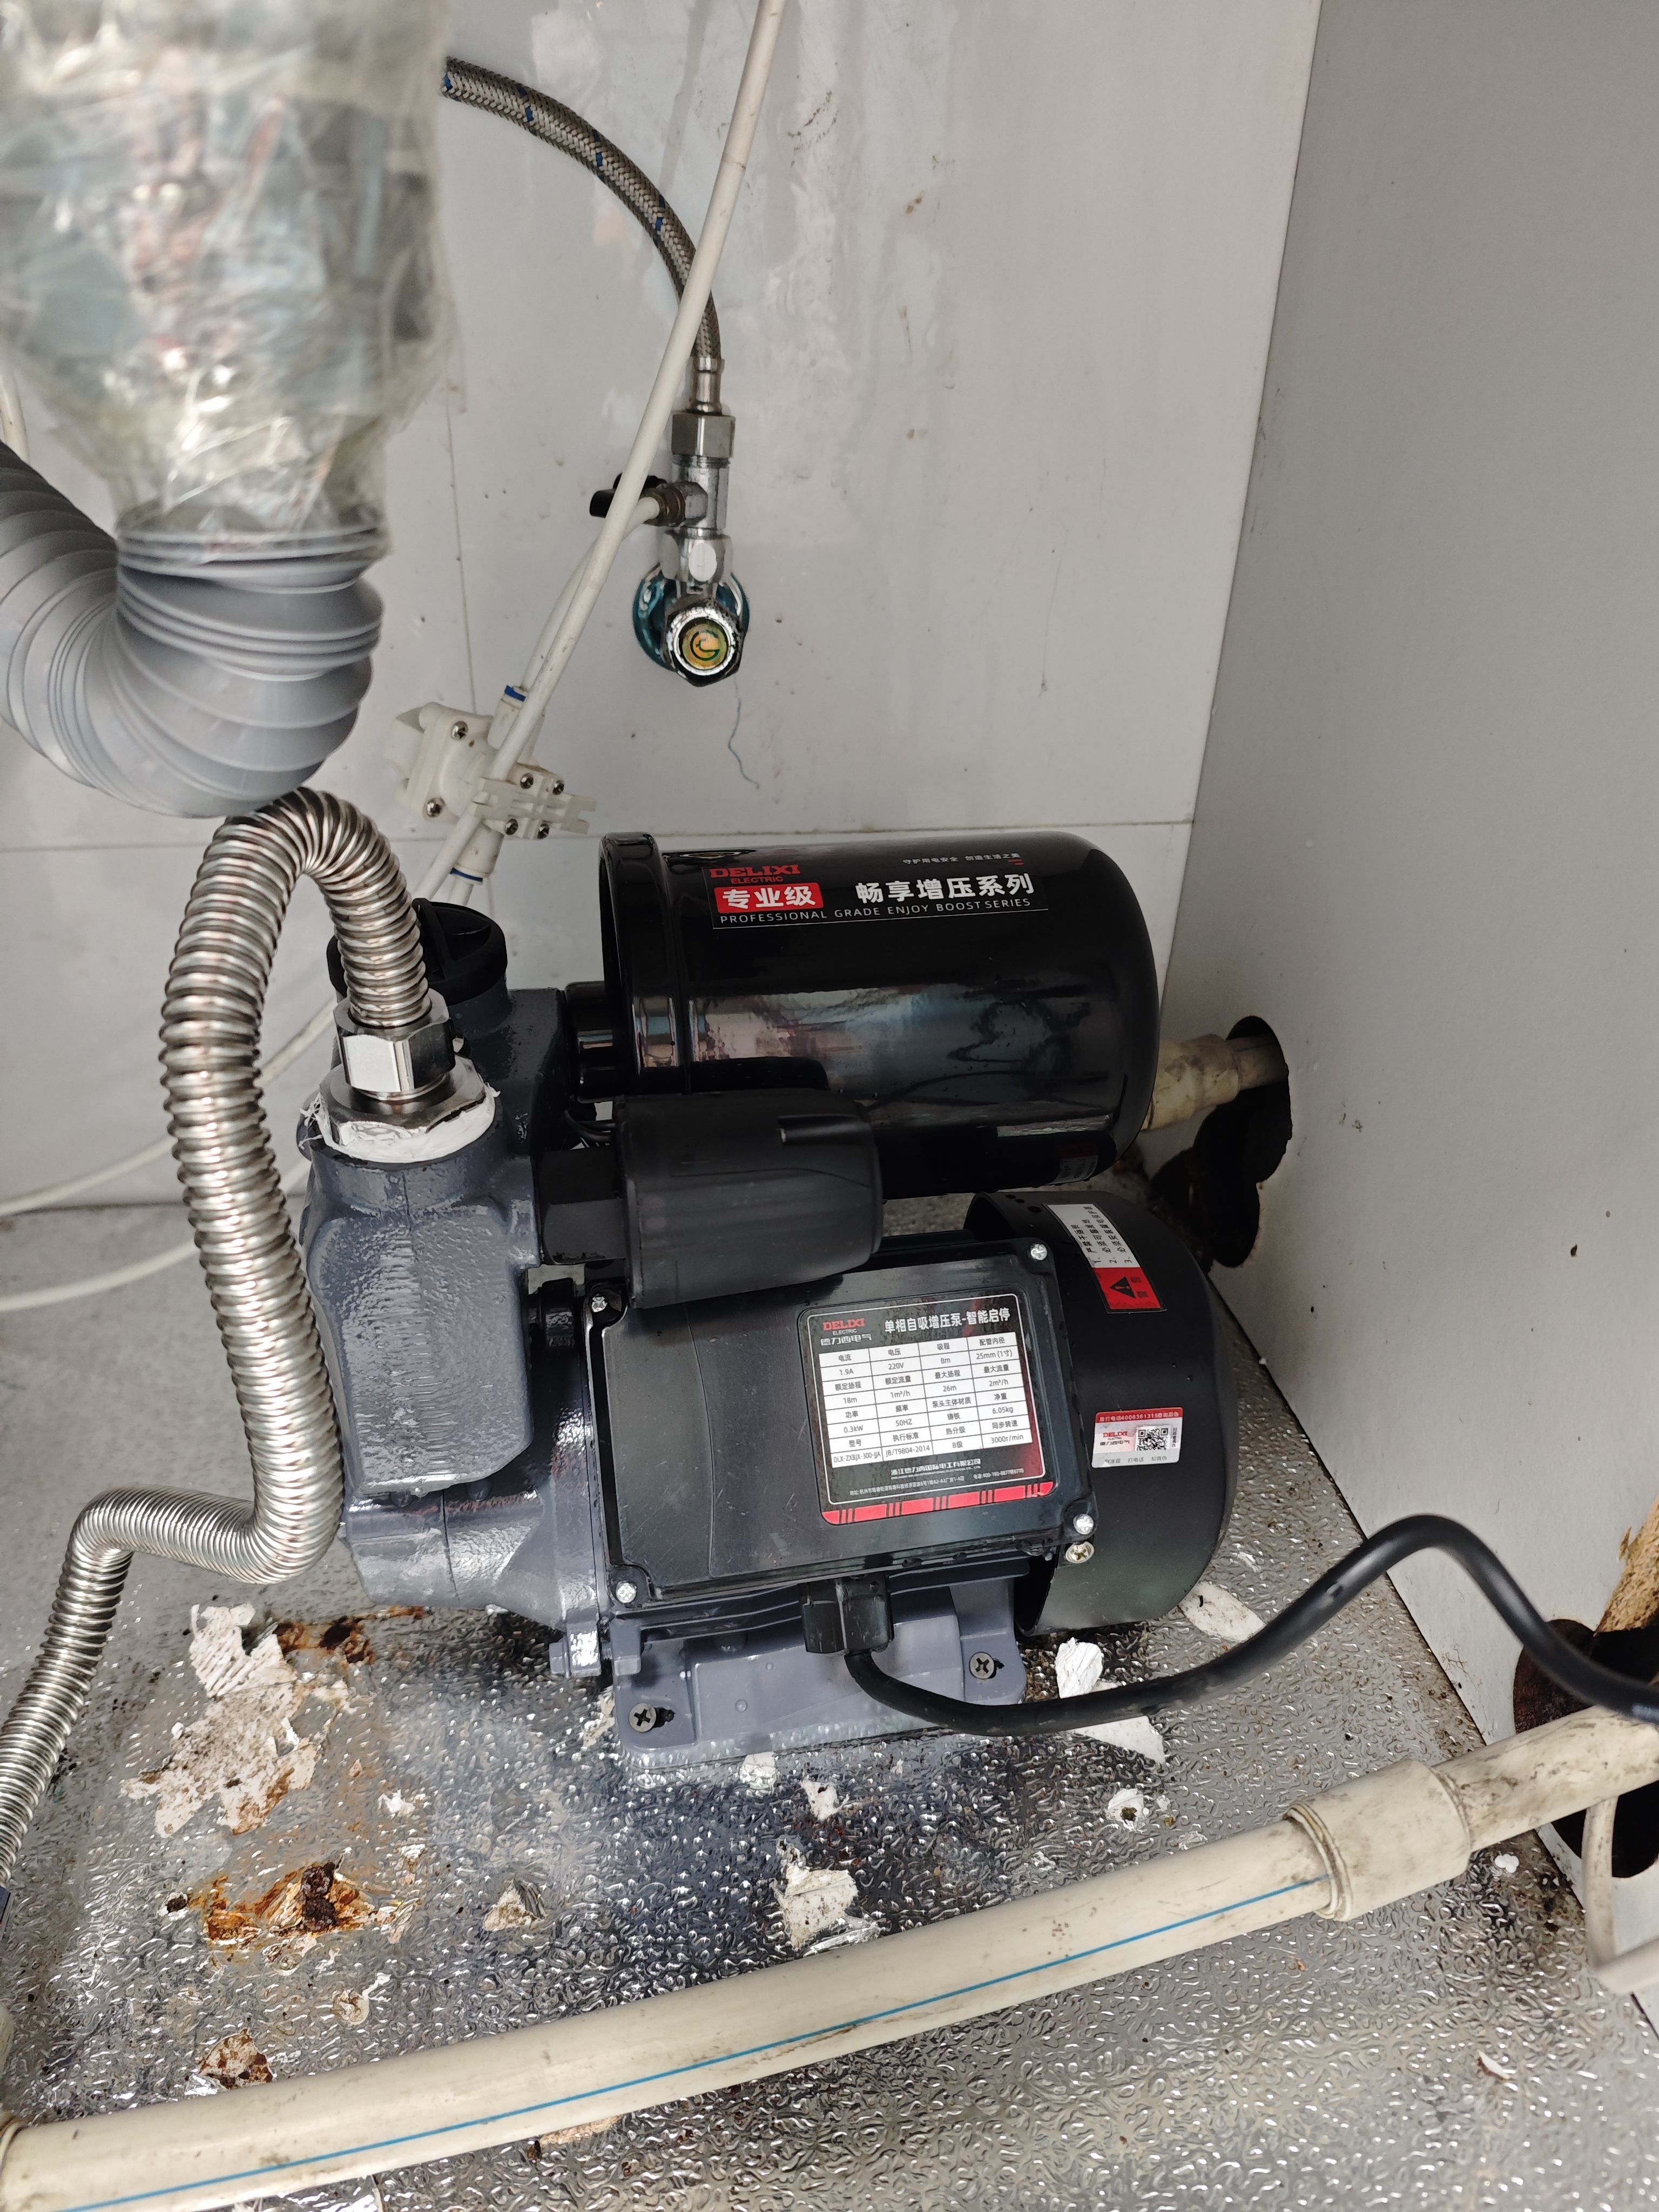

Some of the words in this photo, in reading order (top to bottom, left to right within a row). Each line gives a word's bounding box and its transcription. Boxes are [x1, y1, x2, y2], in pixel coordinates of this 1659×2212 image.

[709, 864, 801, 878] DELIXI
[731, 875, 784, 884] ELECTRIC
[854, 873, 1035, 905] 畅享增压系列
[722, 885, 816, 910] 专业级
[720, 911, 827, 923] PROFESSIONAL
[834, 907, 881, 918] GRADE
[887, 904, 929, 915] ENJOY
[936, 901, 982, 912] BOOST
[984, 898, 1031, 909] SERIES
[822, 1318, 865, 1331] DELIXI
[884, 1307, 1010, 1333] 单相自吸增压泵-智能启停
[820, 1333, 872, 1346] 德力西电气
[979, 1337, 1005, 1346] 配管内径
[937, 1342, 950, 1350] 吸程
[888, 1347, 901, 1355] 电压
[983, 1364, 1009, 1373] 最大流量
[935, 1370, 960, 1379] 最大扬程
[885, 1375, 912, 1384] 额定流量
[835, 1381, 861, 1390] 额定扬程
[994, 1393, 1007, 1401] 净重
[932, 1397, 971, 1408] 泵头主体材质
[895, 1404, 909, 1413] 频率
[992, 1406, 1013, 1415] 6.05kg
[845, 1410, 859, 1419] 功率
[992, 1420, 1018, 1429] 同步转速
[893, 1432, 919, 1442] 执行标准
[991, 1434, 1023, 1444] 3000r/min
[849, 1439, 862, 1447] 型号
[952, 1441, 962, 1449] B级
[885, 1445, 930, 1456] JB/T9804-2014
